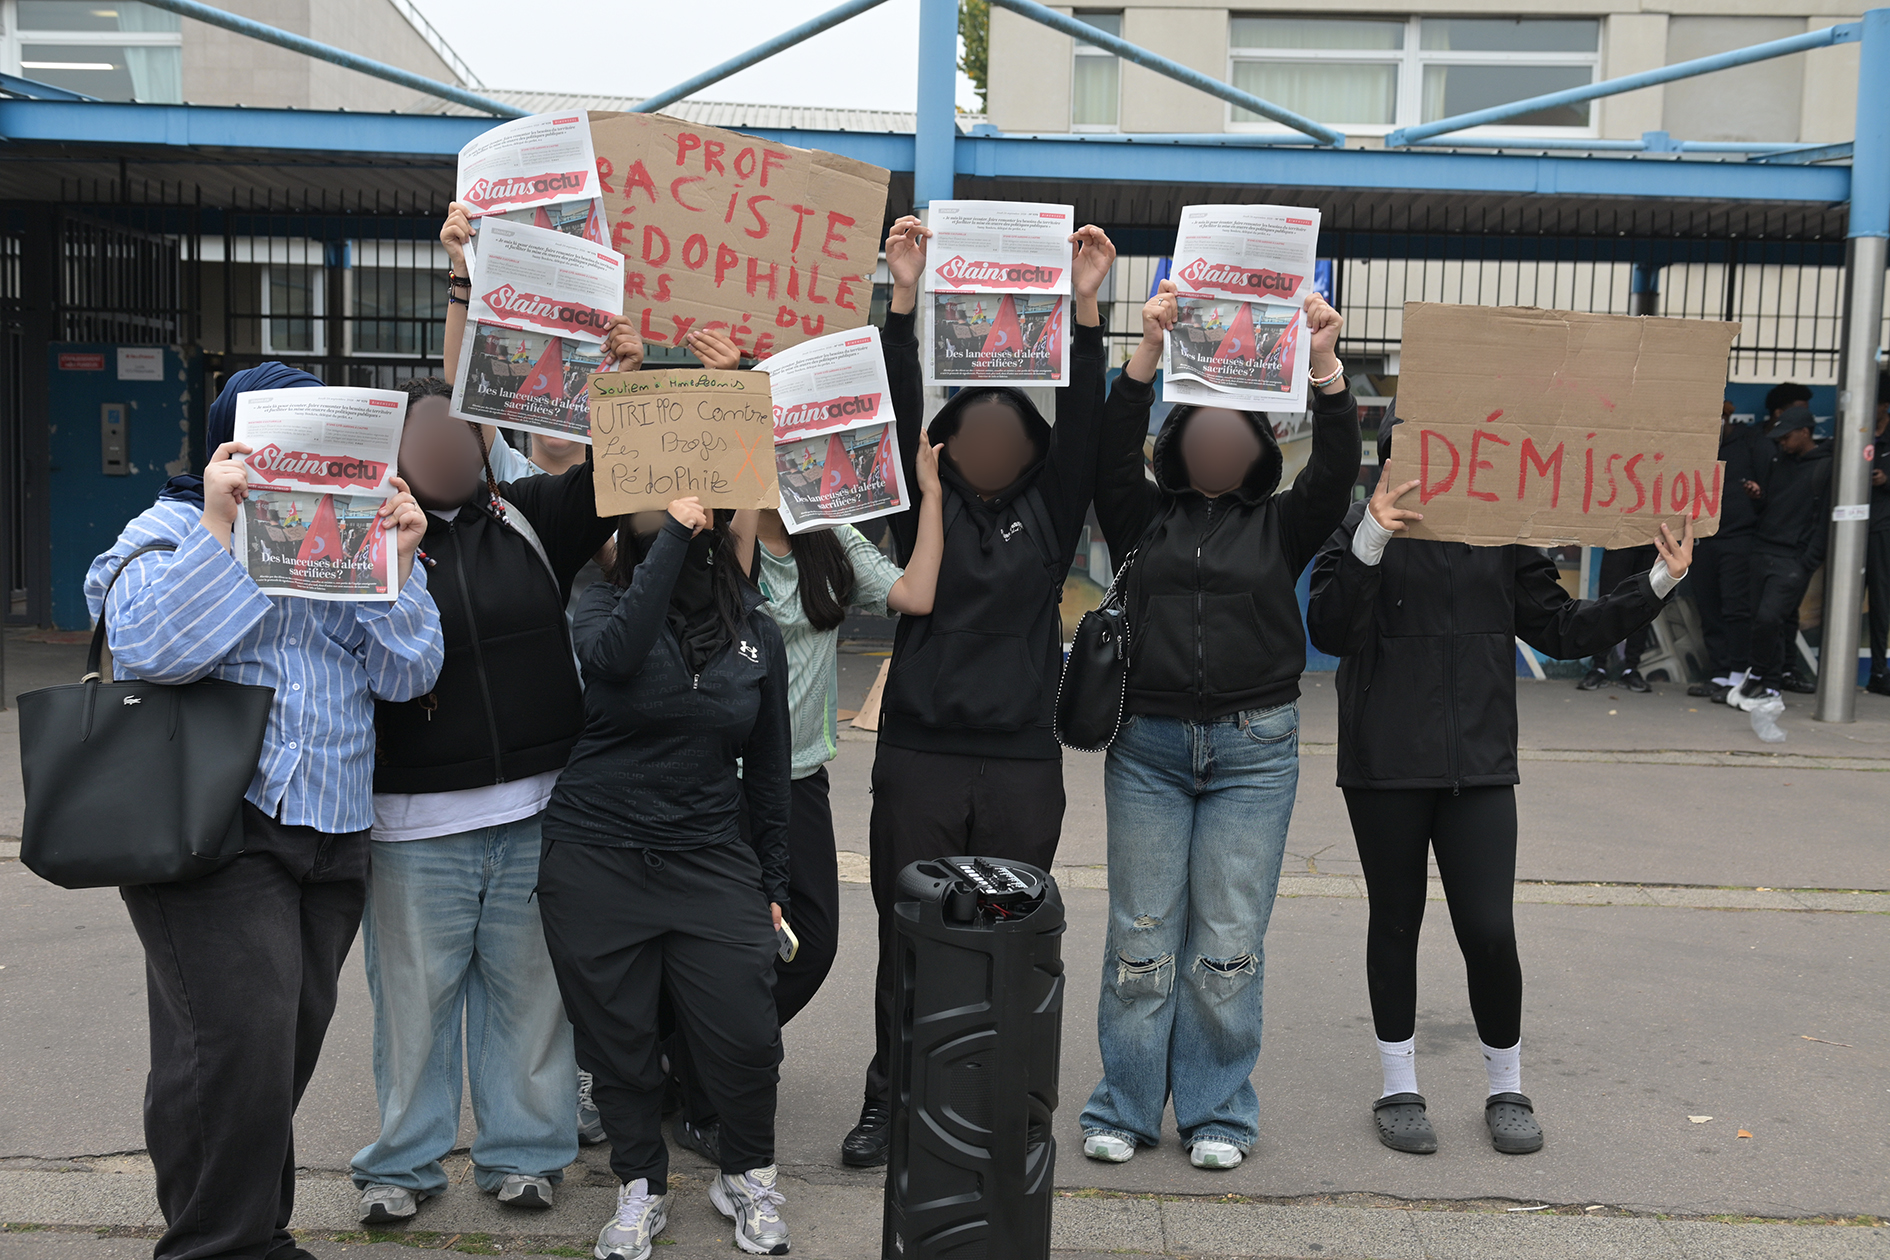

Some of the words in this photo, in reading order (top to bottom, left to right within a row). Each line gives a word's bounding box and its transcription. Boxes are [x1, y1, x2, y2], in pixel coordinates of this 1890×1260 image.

[672, 132, 792, 188] PROF
[469, 173, 580, 202] Stainsactu
[943, 258, 1053, 284] Stainsactu
[1184, 261, 1293, 291] Stainsactu
[489, 287, 608, 329] Stainsactu
[775, 305, 825, 337] DU
[945, 349, 964, 358] Des
[965, 349, 1012, 358] lanceuses
[1014, 349, 1051, 359] d'alerte
[1181, 348, 1196, 361] Des
[1197, 353, 1244, 367] lanceuses
[477, 383, 498, 395] Des
[499, 387, 550, 405] lanceuses
[551, 395, 591, 414] d'alerte
[601, 436, 639, 460] Les
[253, 447, 378, 480] Stainsactu
[261, 552, 281, 563] Des
[282, 554, 330, 569] lanceuses
[332, 557, 374, 571] d'alerte
[640, 759, 699, 770] ARMOUR
